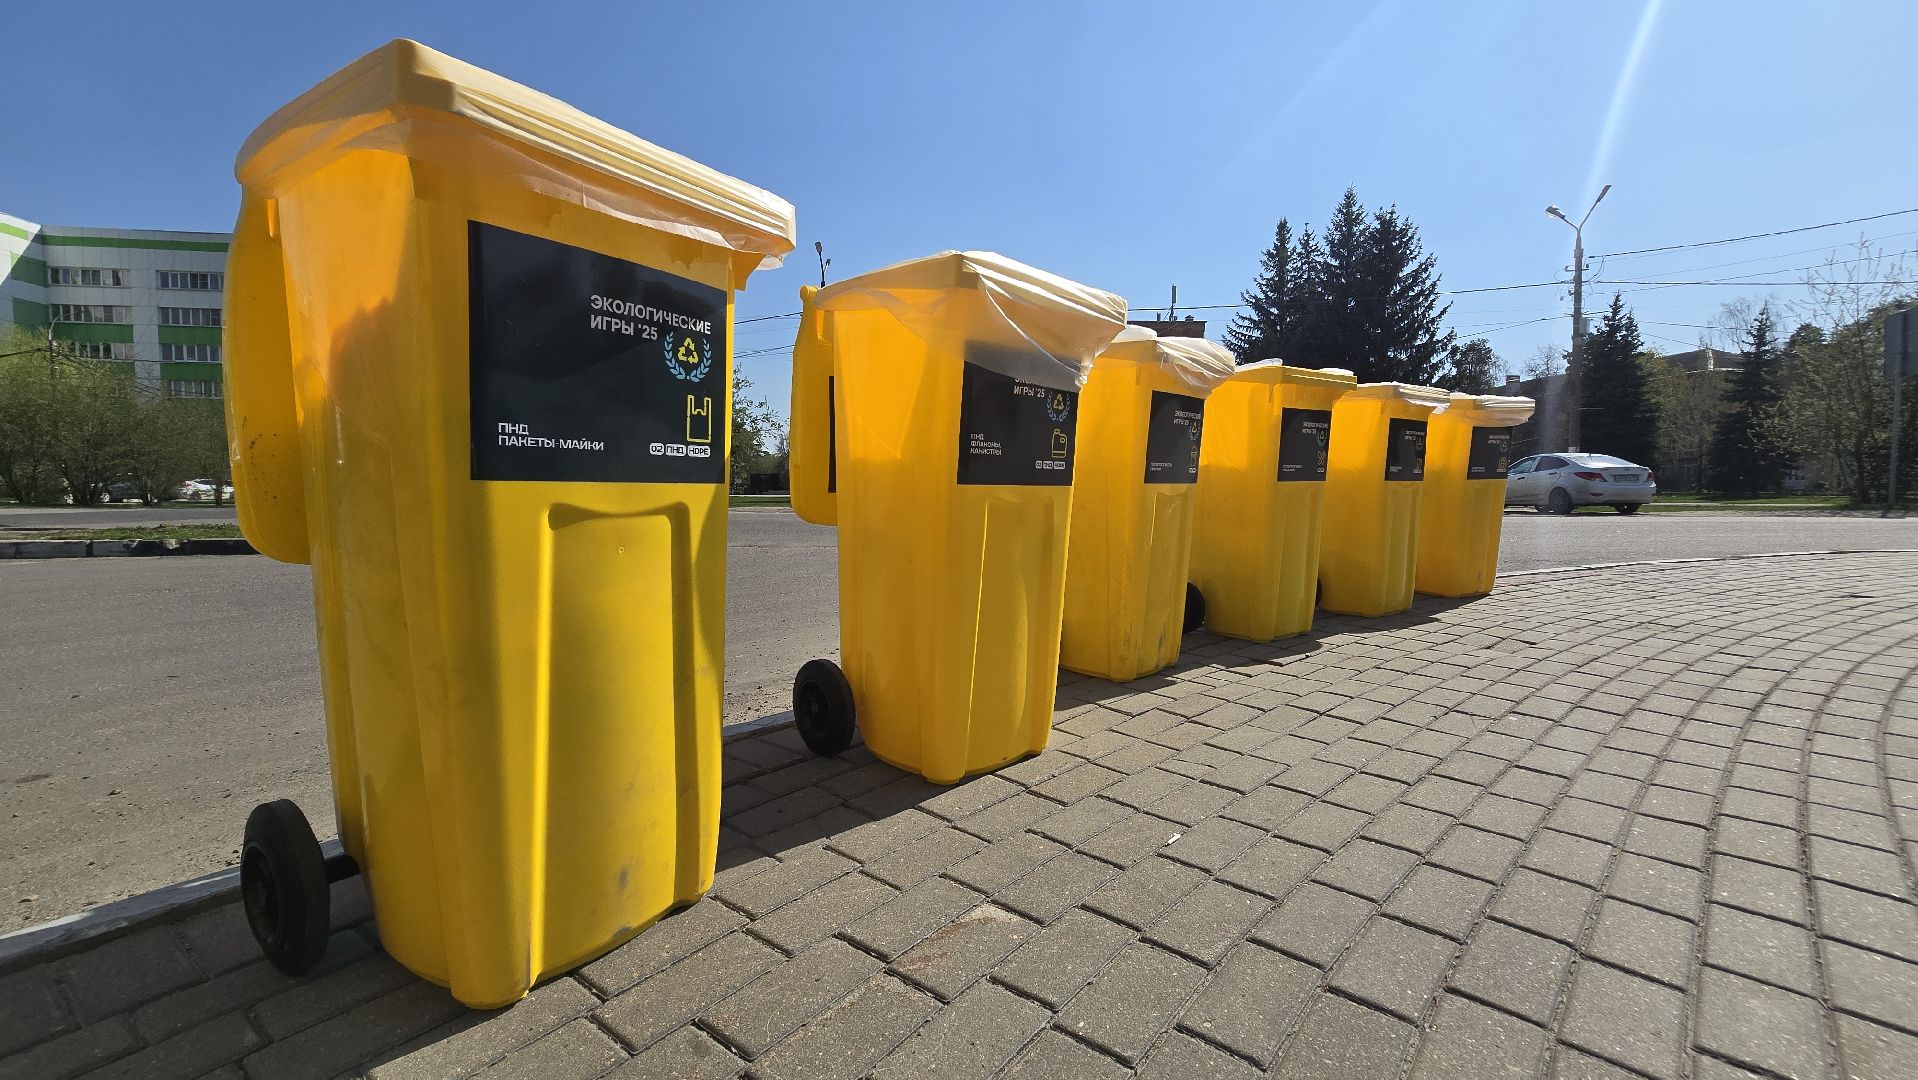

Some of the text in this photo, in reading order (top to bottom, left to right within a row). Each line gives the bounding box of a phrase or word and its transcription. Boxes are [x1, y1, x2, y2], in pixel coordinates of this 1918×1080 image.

[590, 294, 711, 335] ЭКОЛОГИЧЕСКИЕ
[590, 314, 658, 341] ИГРЫ '25
[1013, 385, 1034, 398] ИГРЫ
[498, 422, 529, 435] ПНД
[498, 435, 604, 451] ПАКЕТЫ-МАЙКИ
[651, 445, 663, 454] 02
[666, 445, 685, 455] ПНД
[689, 446, 709, 456] HDPE
[970, 448, 1002, 456] КАНИСТРЫ
